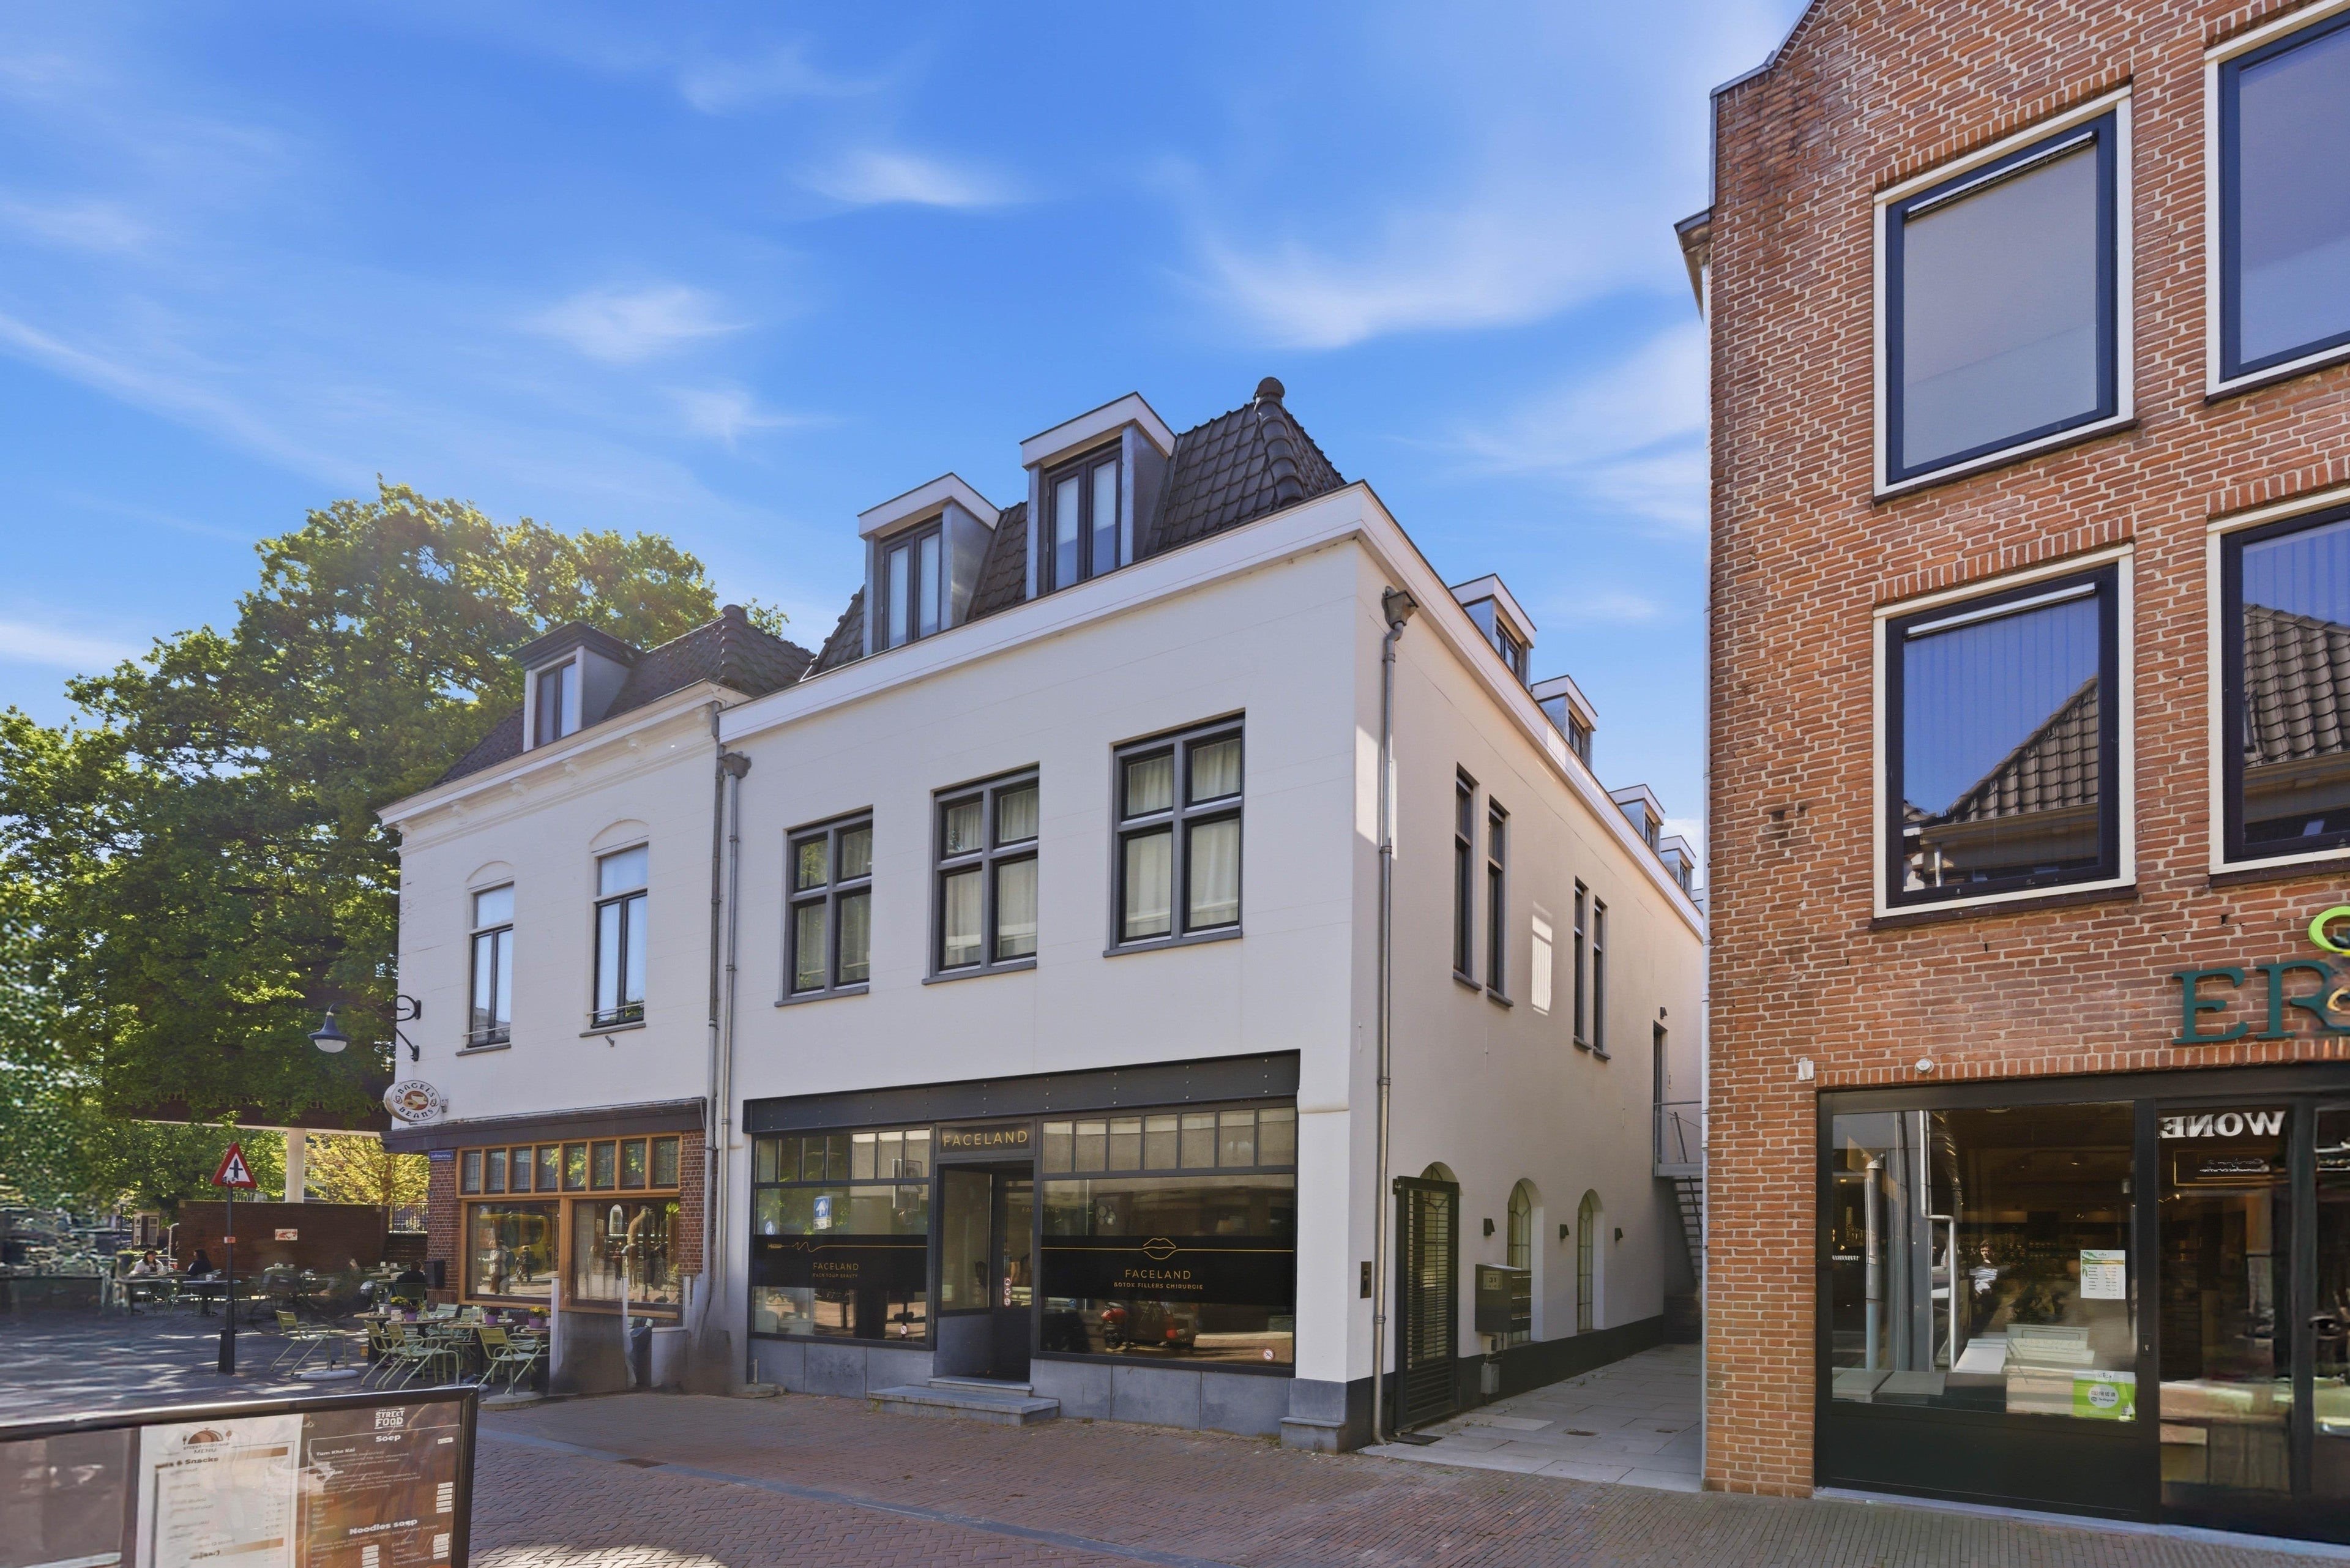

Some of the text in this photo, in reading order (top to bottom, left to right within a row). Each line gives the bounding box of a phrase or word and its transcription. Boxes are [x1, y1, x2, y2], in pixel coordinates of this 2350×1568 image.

[398, 1082, 435, 1097] BAGELS
[398, 1107, 433, 1119] BEANS
[943, 1130, 1028, 1147] FACELAND
[813, 1262, 859, 1271] FACELAND
[1125, 1269, 1191, 1280] FACELAND
[375, 1410, 405, 1419] STREET
[375, 1417, 403, 1427] FOOD
[185, 1456, 219, 1465] Snacks
[349, 1523, 392, 1535] Noodles
